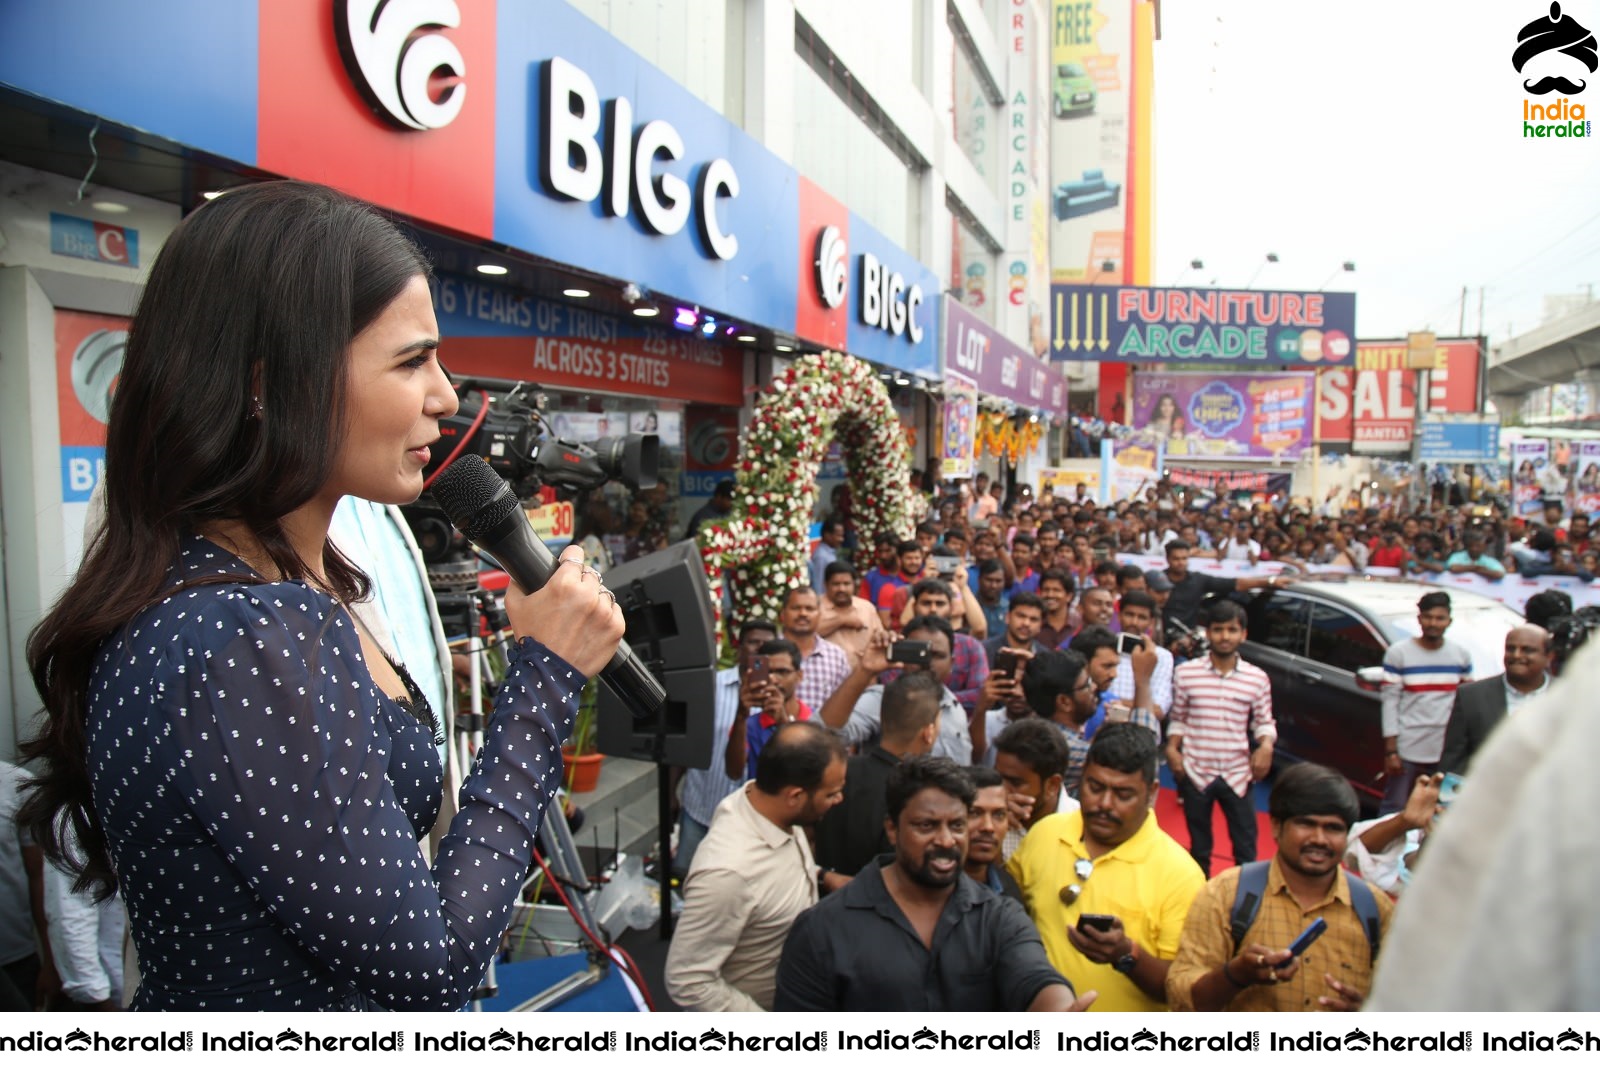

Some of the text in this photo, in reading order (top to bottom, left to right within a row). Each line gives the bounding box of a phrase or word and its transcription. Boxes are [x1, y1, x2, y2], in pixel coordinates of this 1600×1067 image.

[1055, 2, 1092, 47] FREE
[541, 55, 740, 261] BIG C
[1011, 90, 1027, 220] ARCADE
[63, 229, 124, 261] Big C
[463, 282, 532, 330] YEARS
[536, 303, 562, 335] OF
[568, 307, 620, 346] TRUST
[859, 252, 924, 344] BIG C
[1116, 287, 1325, 326] FURNITURE
[533, 337, 670, 388] ACROSS 3 STATES
[956, 321, 986, 375] LOT
[1117, 325, 1268, 358] ARCADE
[1319, 369, 1448, 421] SALE
[683, 476, 716, 492] BIG
[551, 504, 571, 536] 30
